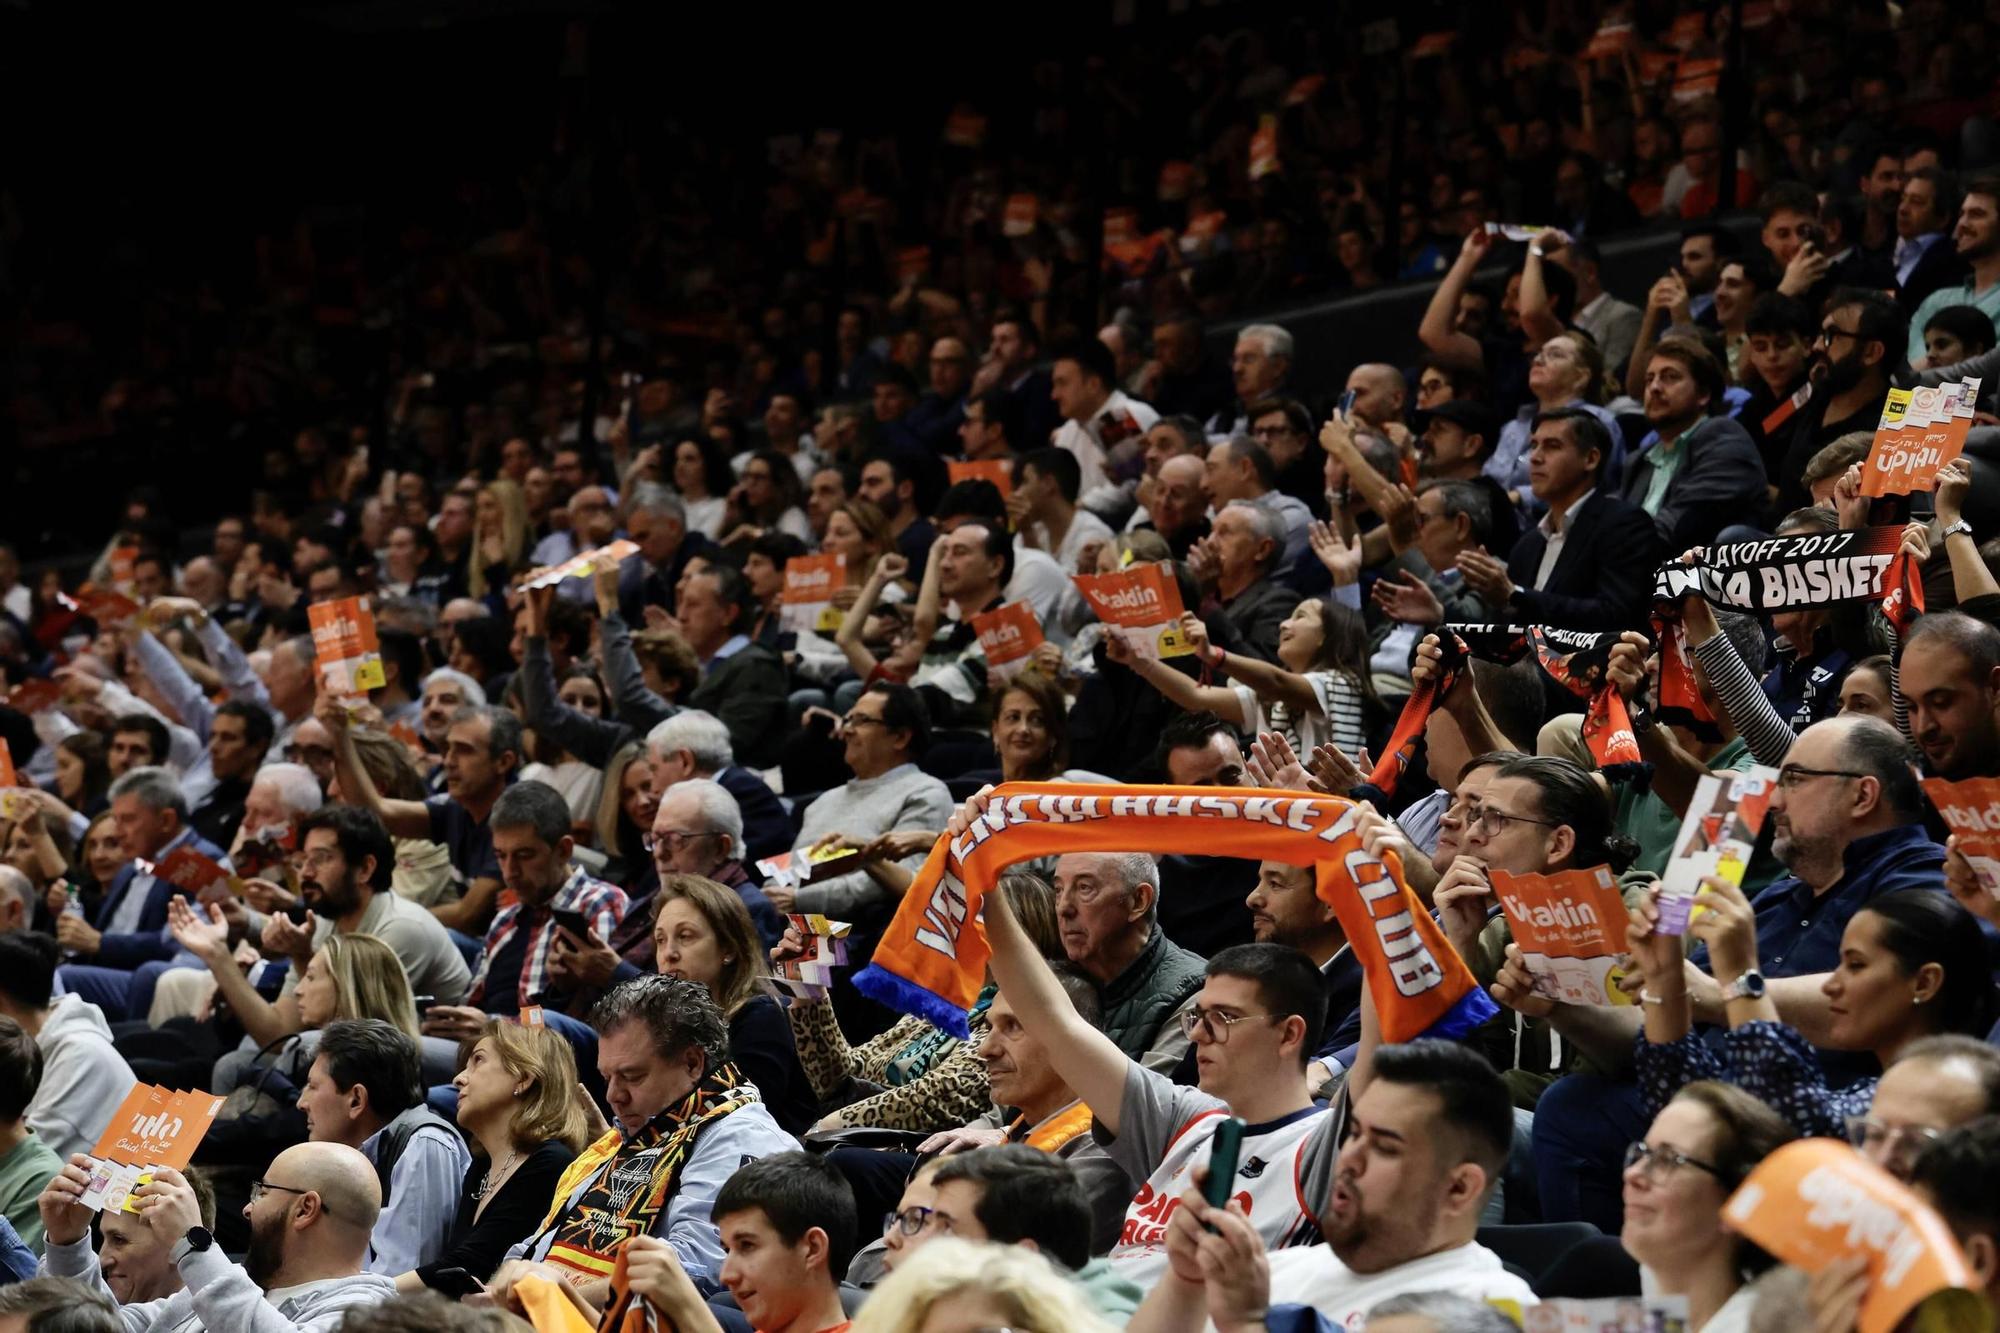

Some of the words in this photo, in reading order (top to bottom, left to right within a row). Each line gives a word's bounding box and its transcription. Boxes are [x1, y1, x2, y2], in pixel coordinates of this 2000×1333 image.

[1784, 532, 1855, 558] 2017
[1758, 553, 1895, 609] BASKET
[1344, 848, 1444, 997] CLUB
